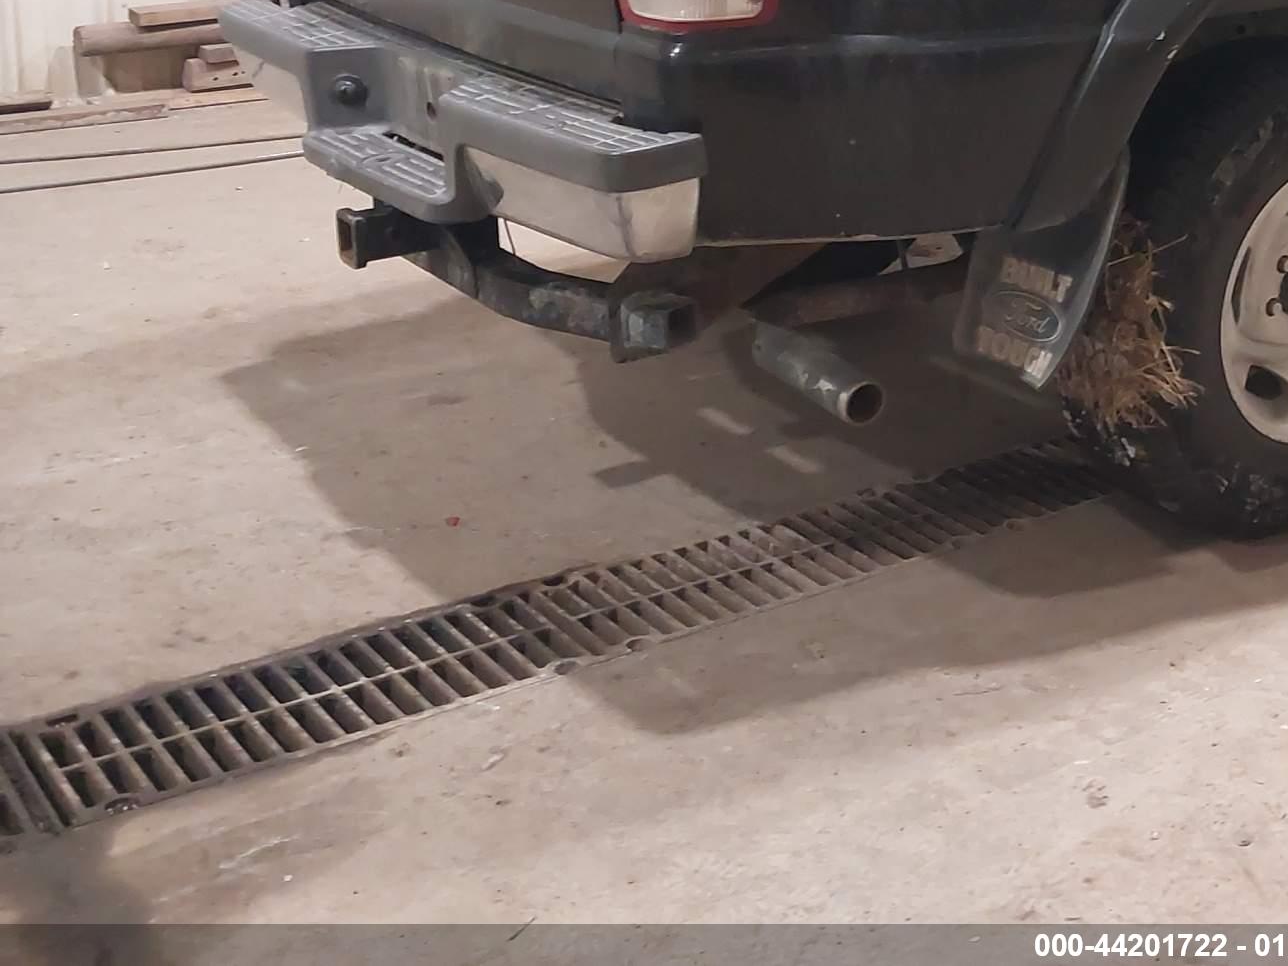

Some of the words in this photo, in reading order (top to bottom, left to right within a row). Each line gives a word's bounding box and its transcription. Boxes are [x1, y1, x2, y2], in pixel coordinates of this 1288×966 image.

[1001, 256, 1073, 303] BUILT
[1003, 298, 1050, 334] Ford
[978, 325, 1053, 378] TOUGH
